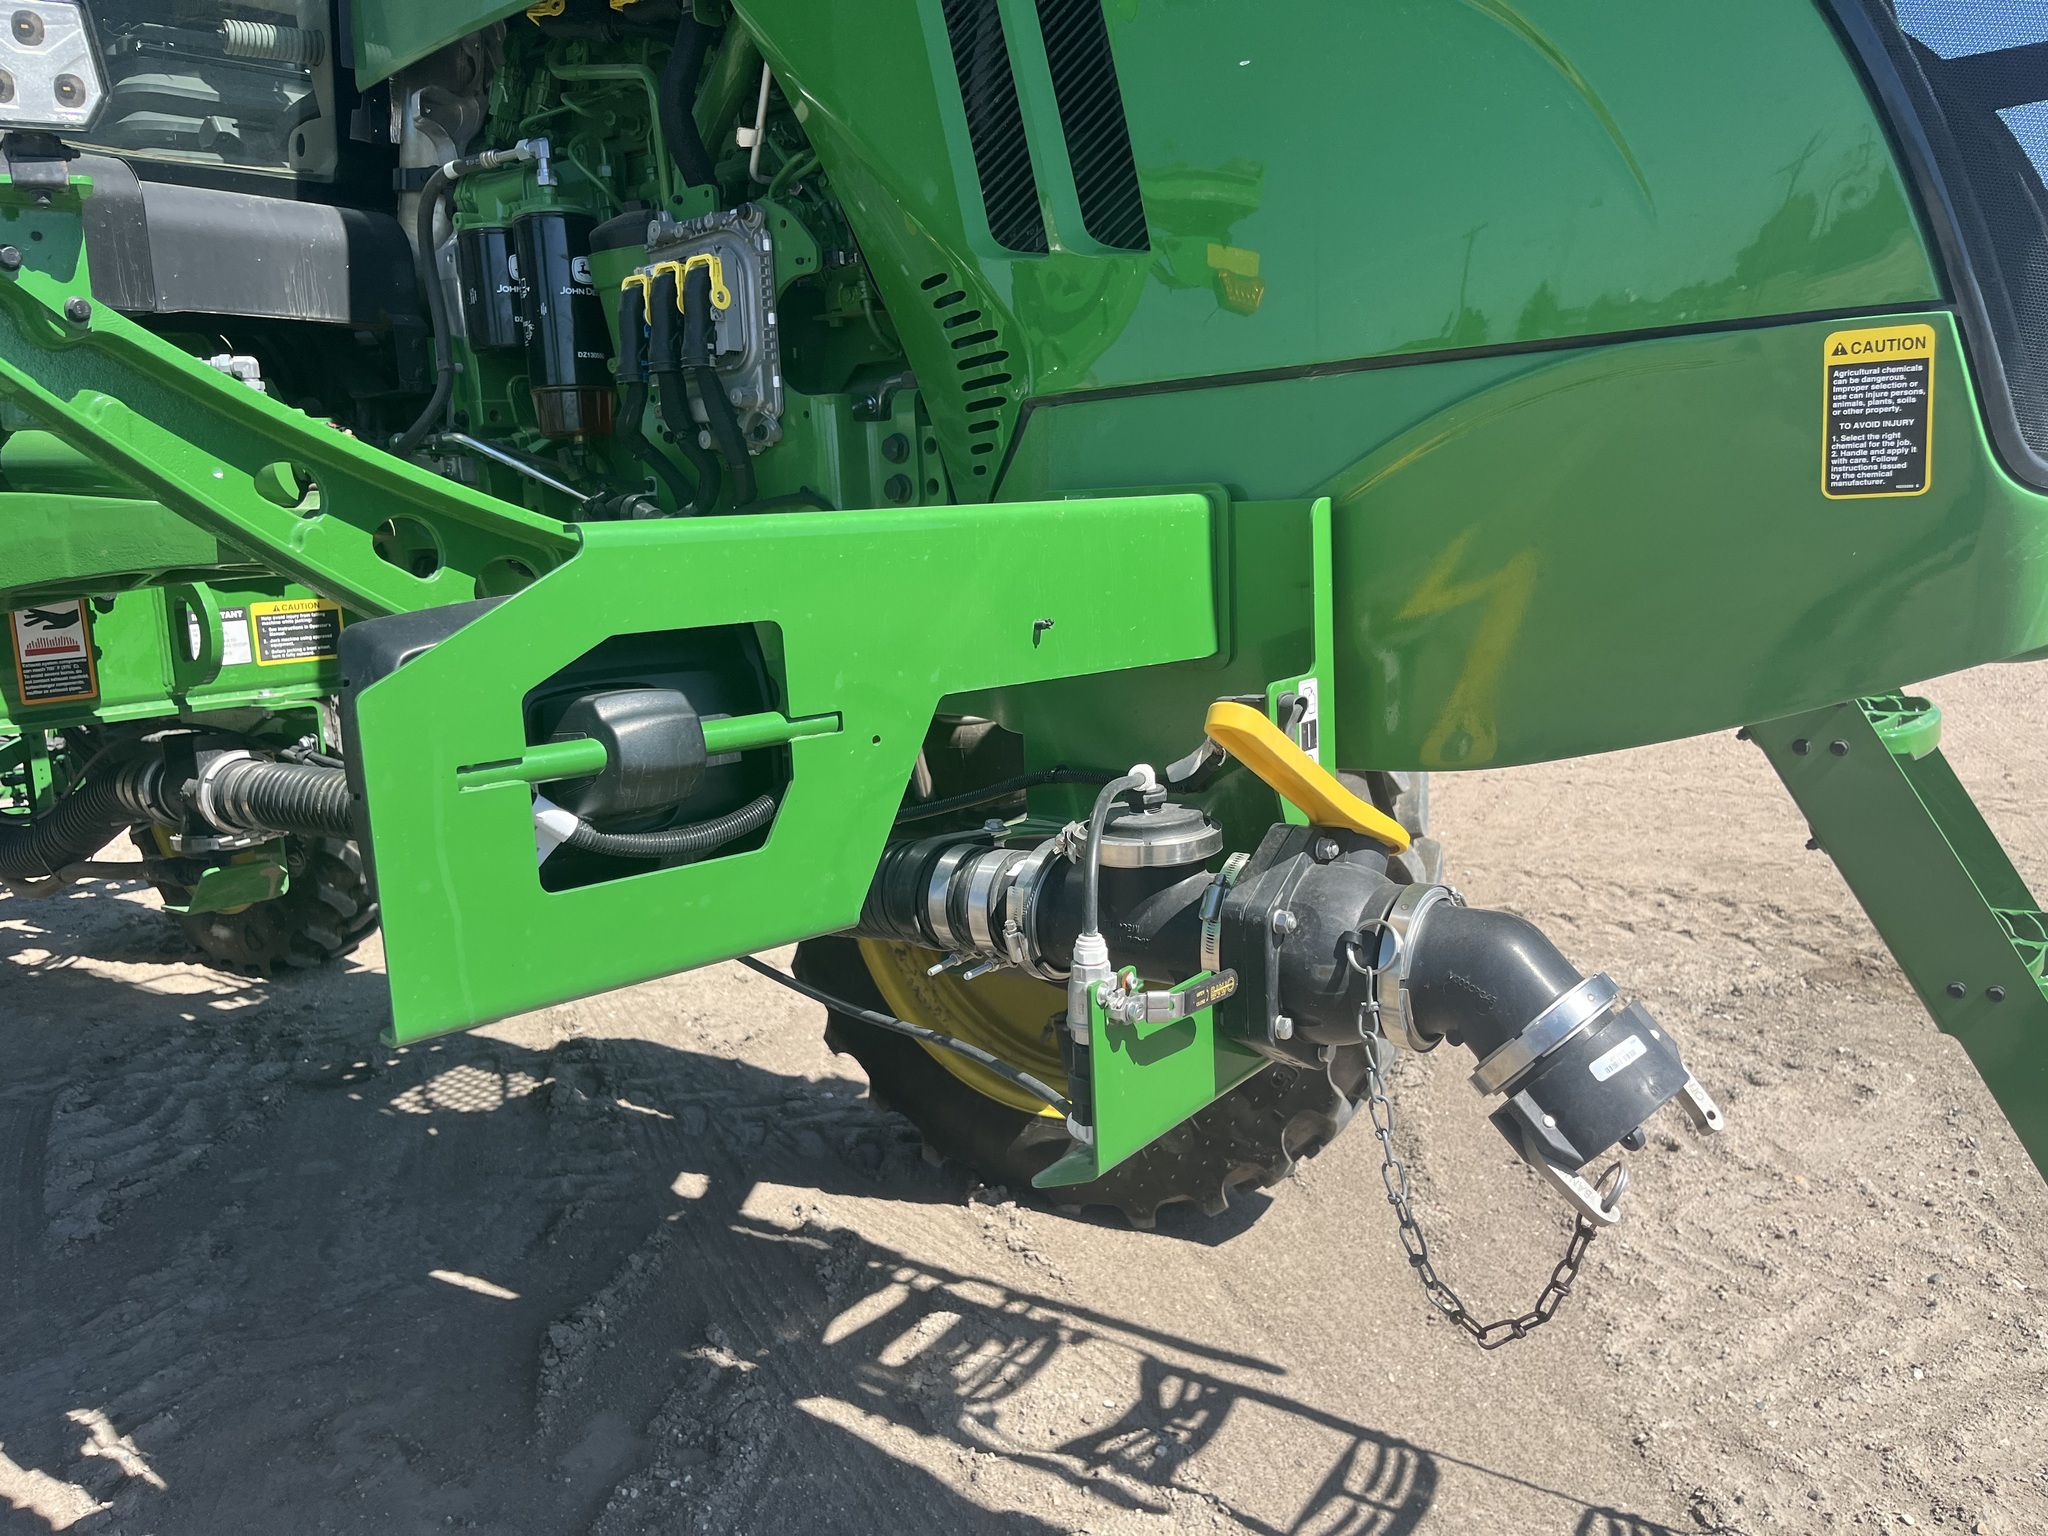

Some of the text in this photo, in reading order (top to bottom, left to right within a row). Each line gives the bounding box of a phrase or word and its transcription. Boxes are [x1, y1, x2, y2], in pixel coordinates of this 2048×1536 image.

[560, 286, 585, 295] JOHN
[1851, 336, 1926, 354] CAUTION
[1833, 364, 1923, 378] Agricultural chemicals
[1850, 376, 1859, 384] be
[1861, 374, 1906, 384] dangerous.
[1833, 384, 1868, 394] Improper
[1871, 381, 1908, 390] selection
[1866, 390, 1888, 400] injure
[1890, 389, 1926, 398] persons,
[1832, 396, 1917, 408] animals, plants, soils
[1866, 406, 1902, 415] property.
[1853, 421, 1880, 429] AVOID
[1882, 419, 1915, 427] INJURY
[1841, 434, 1865, 442] Select
[1882, 432, 1901, 440] right
[1831, 441, 1867, 450] chemical
[1897, 440, 1912, 448] job.
[1840, 449, 1868, 457] Handle
[1887, 447, 1909, 455] apply
[1871, 455, 1898, 463] Follow
[1831, 462, 1907, 472] instructions issued
[1857, 470, 1893, 478] chemical
[1831, 479, 1886, 487] manufacturer.
[282, 602, 320, 611] CAUTION
